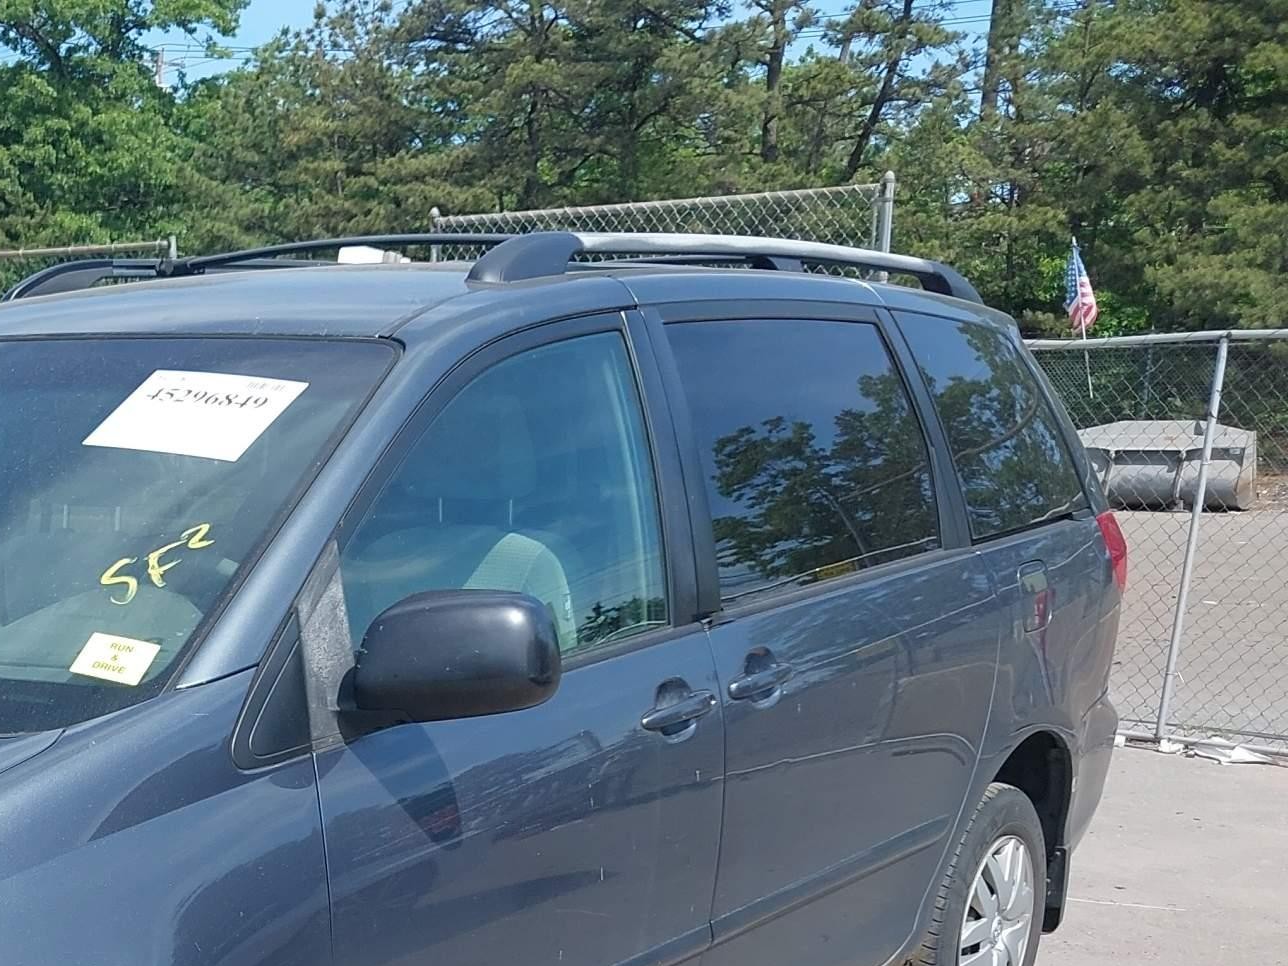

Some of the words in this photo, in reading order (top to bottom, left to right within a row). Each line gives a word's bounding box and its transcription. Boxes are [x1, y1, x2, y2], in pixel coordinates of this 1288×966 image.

[146, 387, 269, 410] 45296849
[109, 642, 135, 653] RUN
[91, 661, 126, 674] DRIVE
